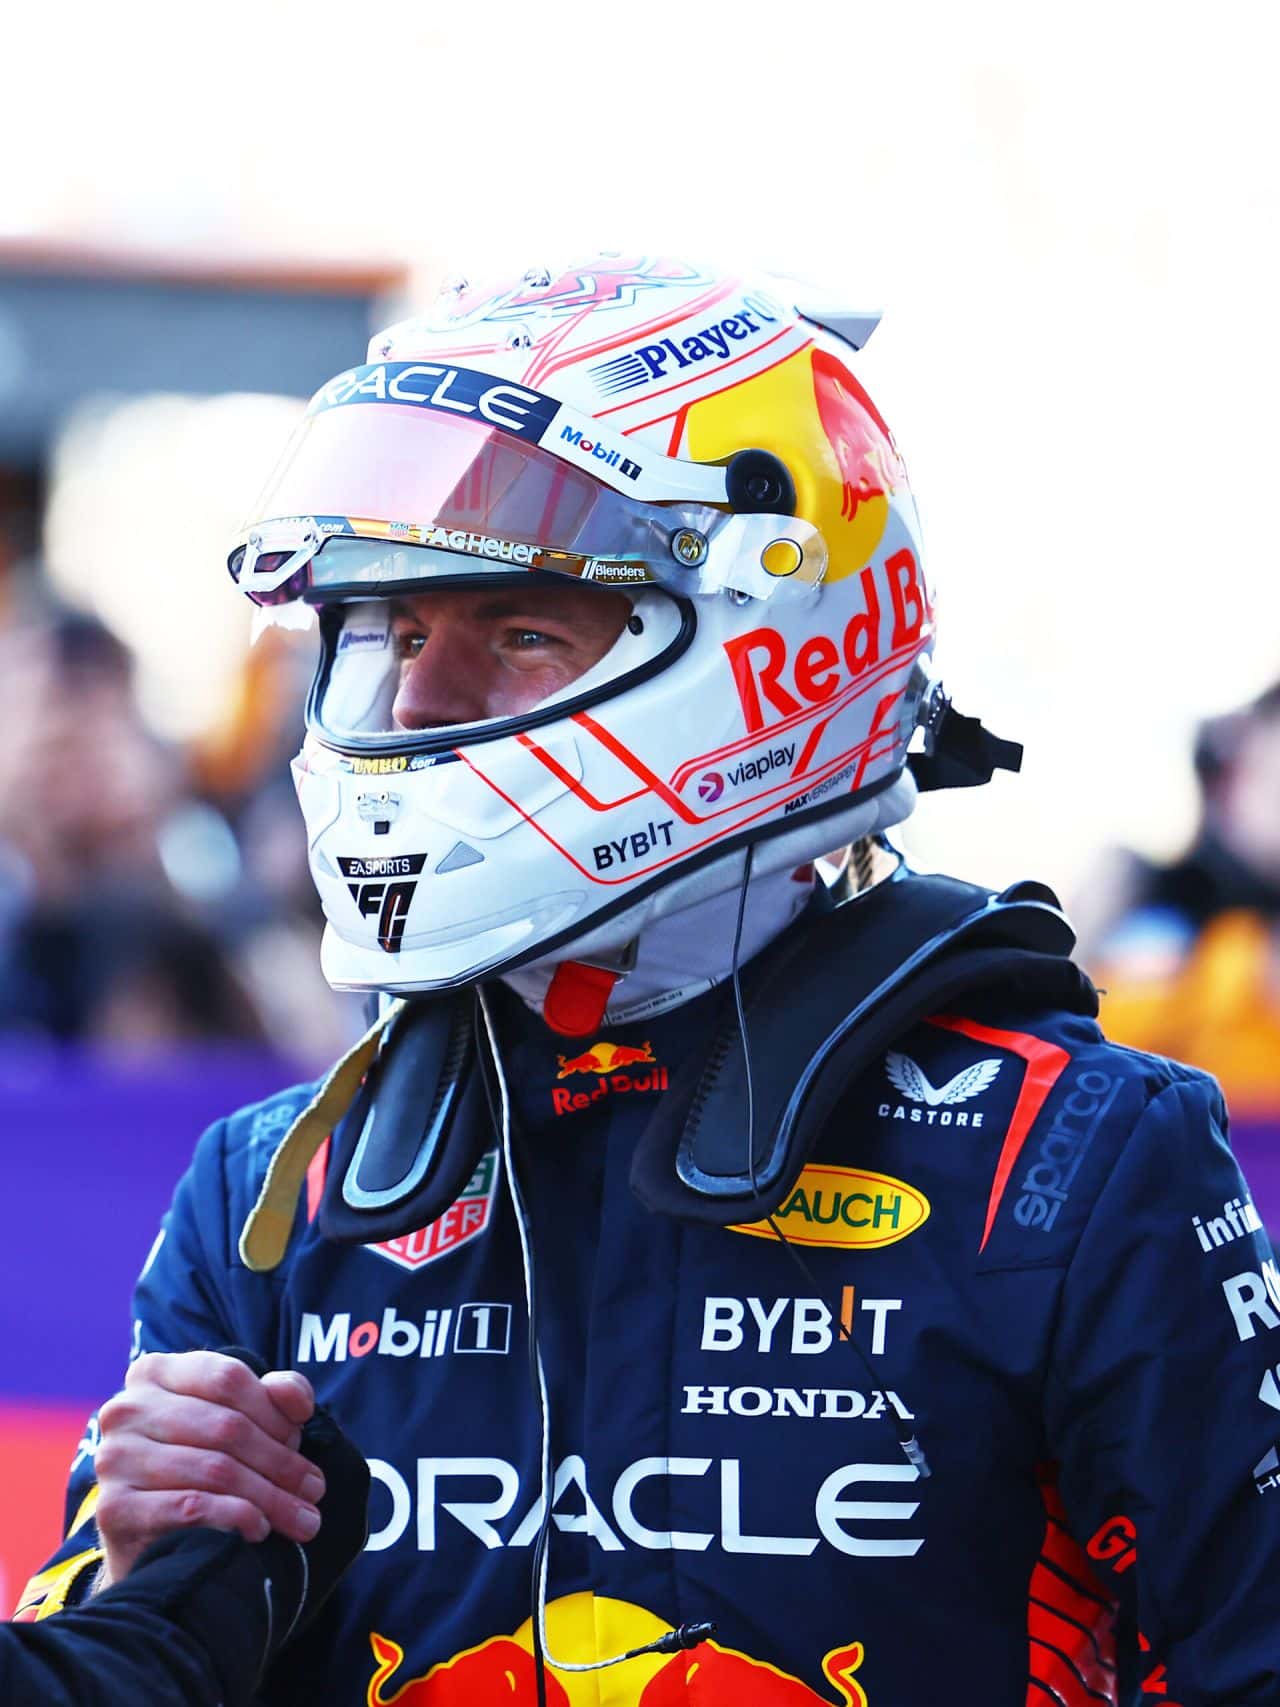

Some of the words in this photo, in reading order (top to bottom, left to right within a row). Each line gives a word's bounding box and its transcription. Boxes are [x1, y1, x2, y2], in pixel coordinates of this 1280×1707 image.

[310, 366, 541, 431] RACLE
[560, 425, 621, 468] Mobil
[596, 565, 646, 578] Blenders
[723, 567, 880, 734] Red
[885, 547, 936, 653] B
[351, 757, 436, 774] UMBO.com
[727, 744, 796, 787] viaplay
[364, 858, 410, 874] SPORTS
[593, 820, 674, 871] BYBIT
[552, 1077, 609, 1116] Red
[611, 1067, 670, 1093] Bull
[877, 1104, 984, 1128] CASTORE
[1014, 1070, 1114, 1228] sparco
[775, 1188, 901, 1229] AUCH
[297, 1307, 453, 1363] Mobil
[701, 1286, 902, 1355] BYBIT
[680, 1386, 915, 1420] HONDA
